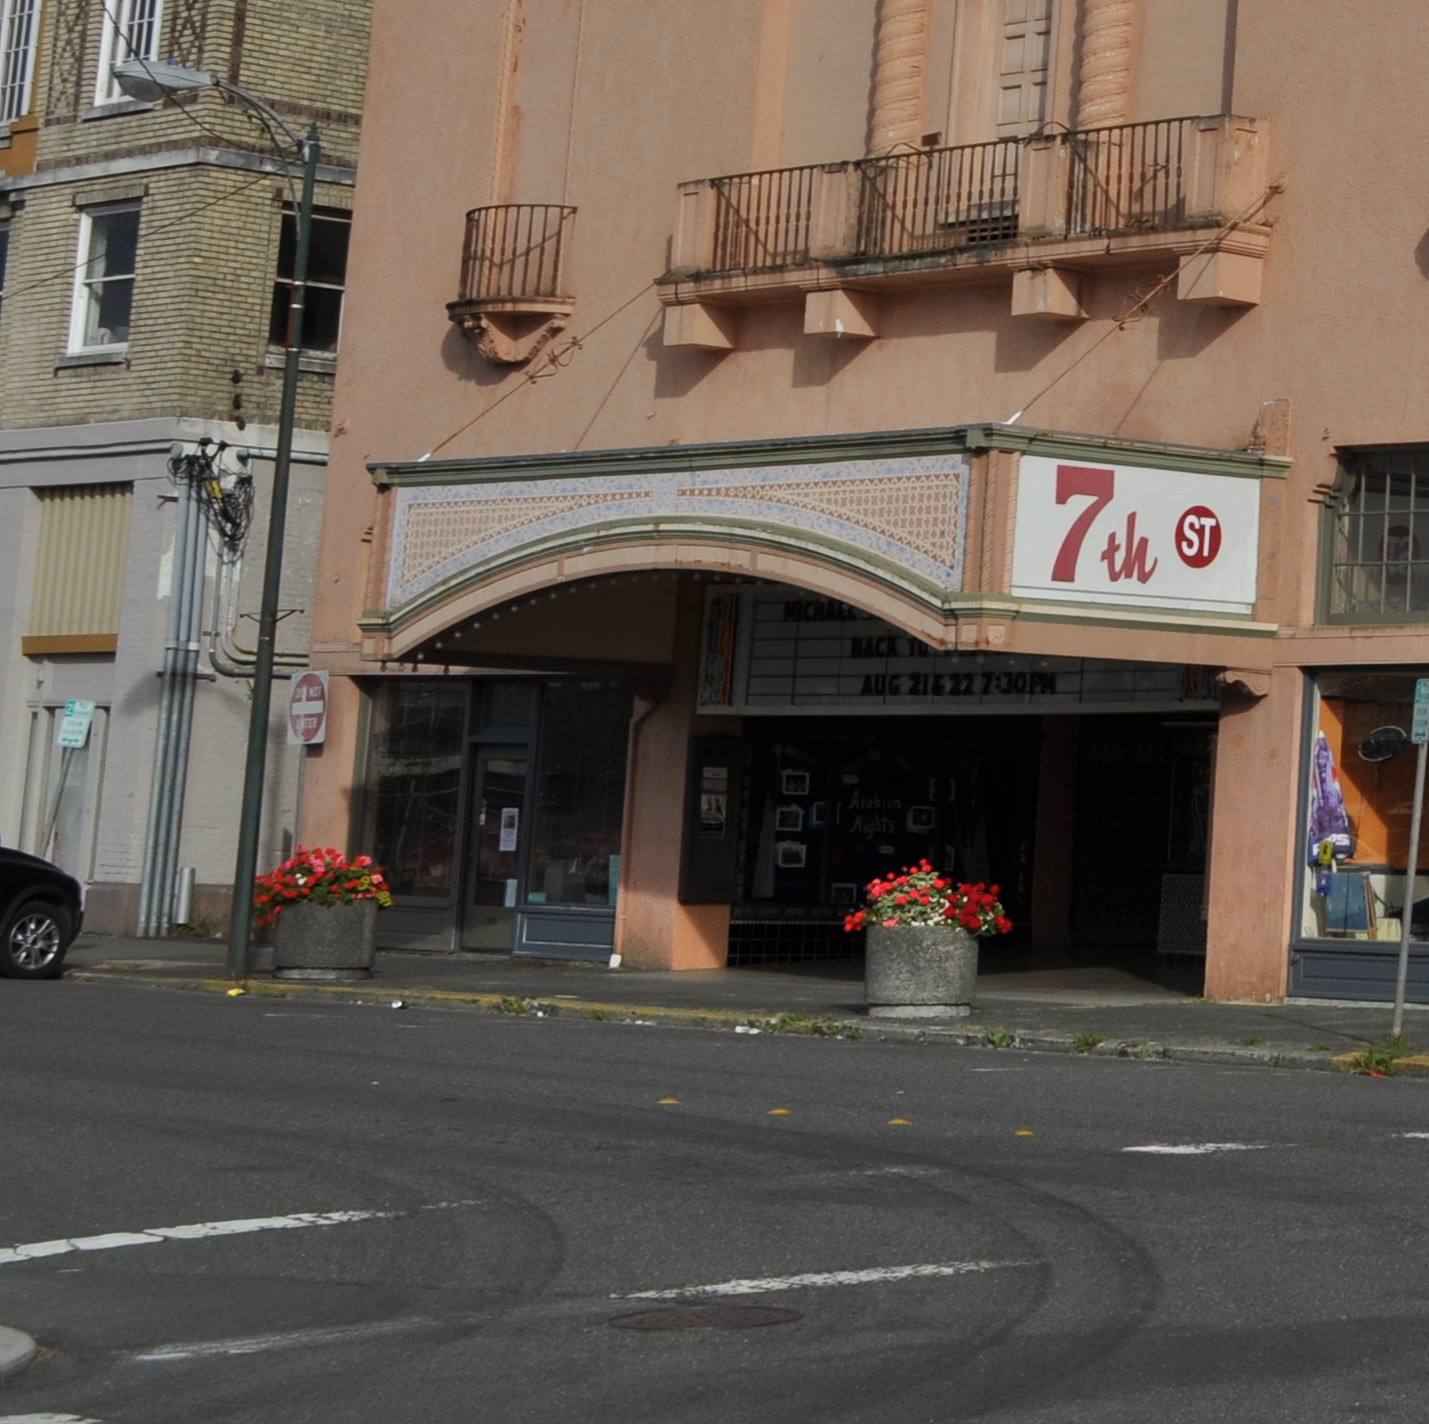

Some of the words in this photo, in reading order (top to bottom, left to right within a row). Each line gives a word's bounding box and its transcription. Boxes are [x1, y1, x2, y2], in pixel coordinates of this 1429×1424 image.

[1051, 465, 1158, 584] 7th
[1181, 514, 1216, 556] ST
[851, 636, 898, 657] BACK
[861, 673, 900, 695] AUG
[847, 787, 902, 810] Arabian
[849, 812, 896, 841] Nights
